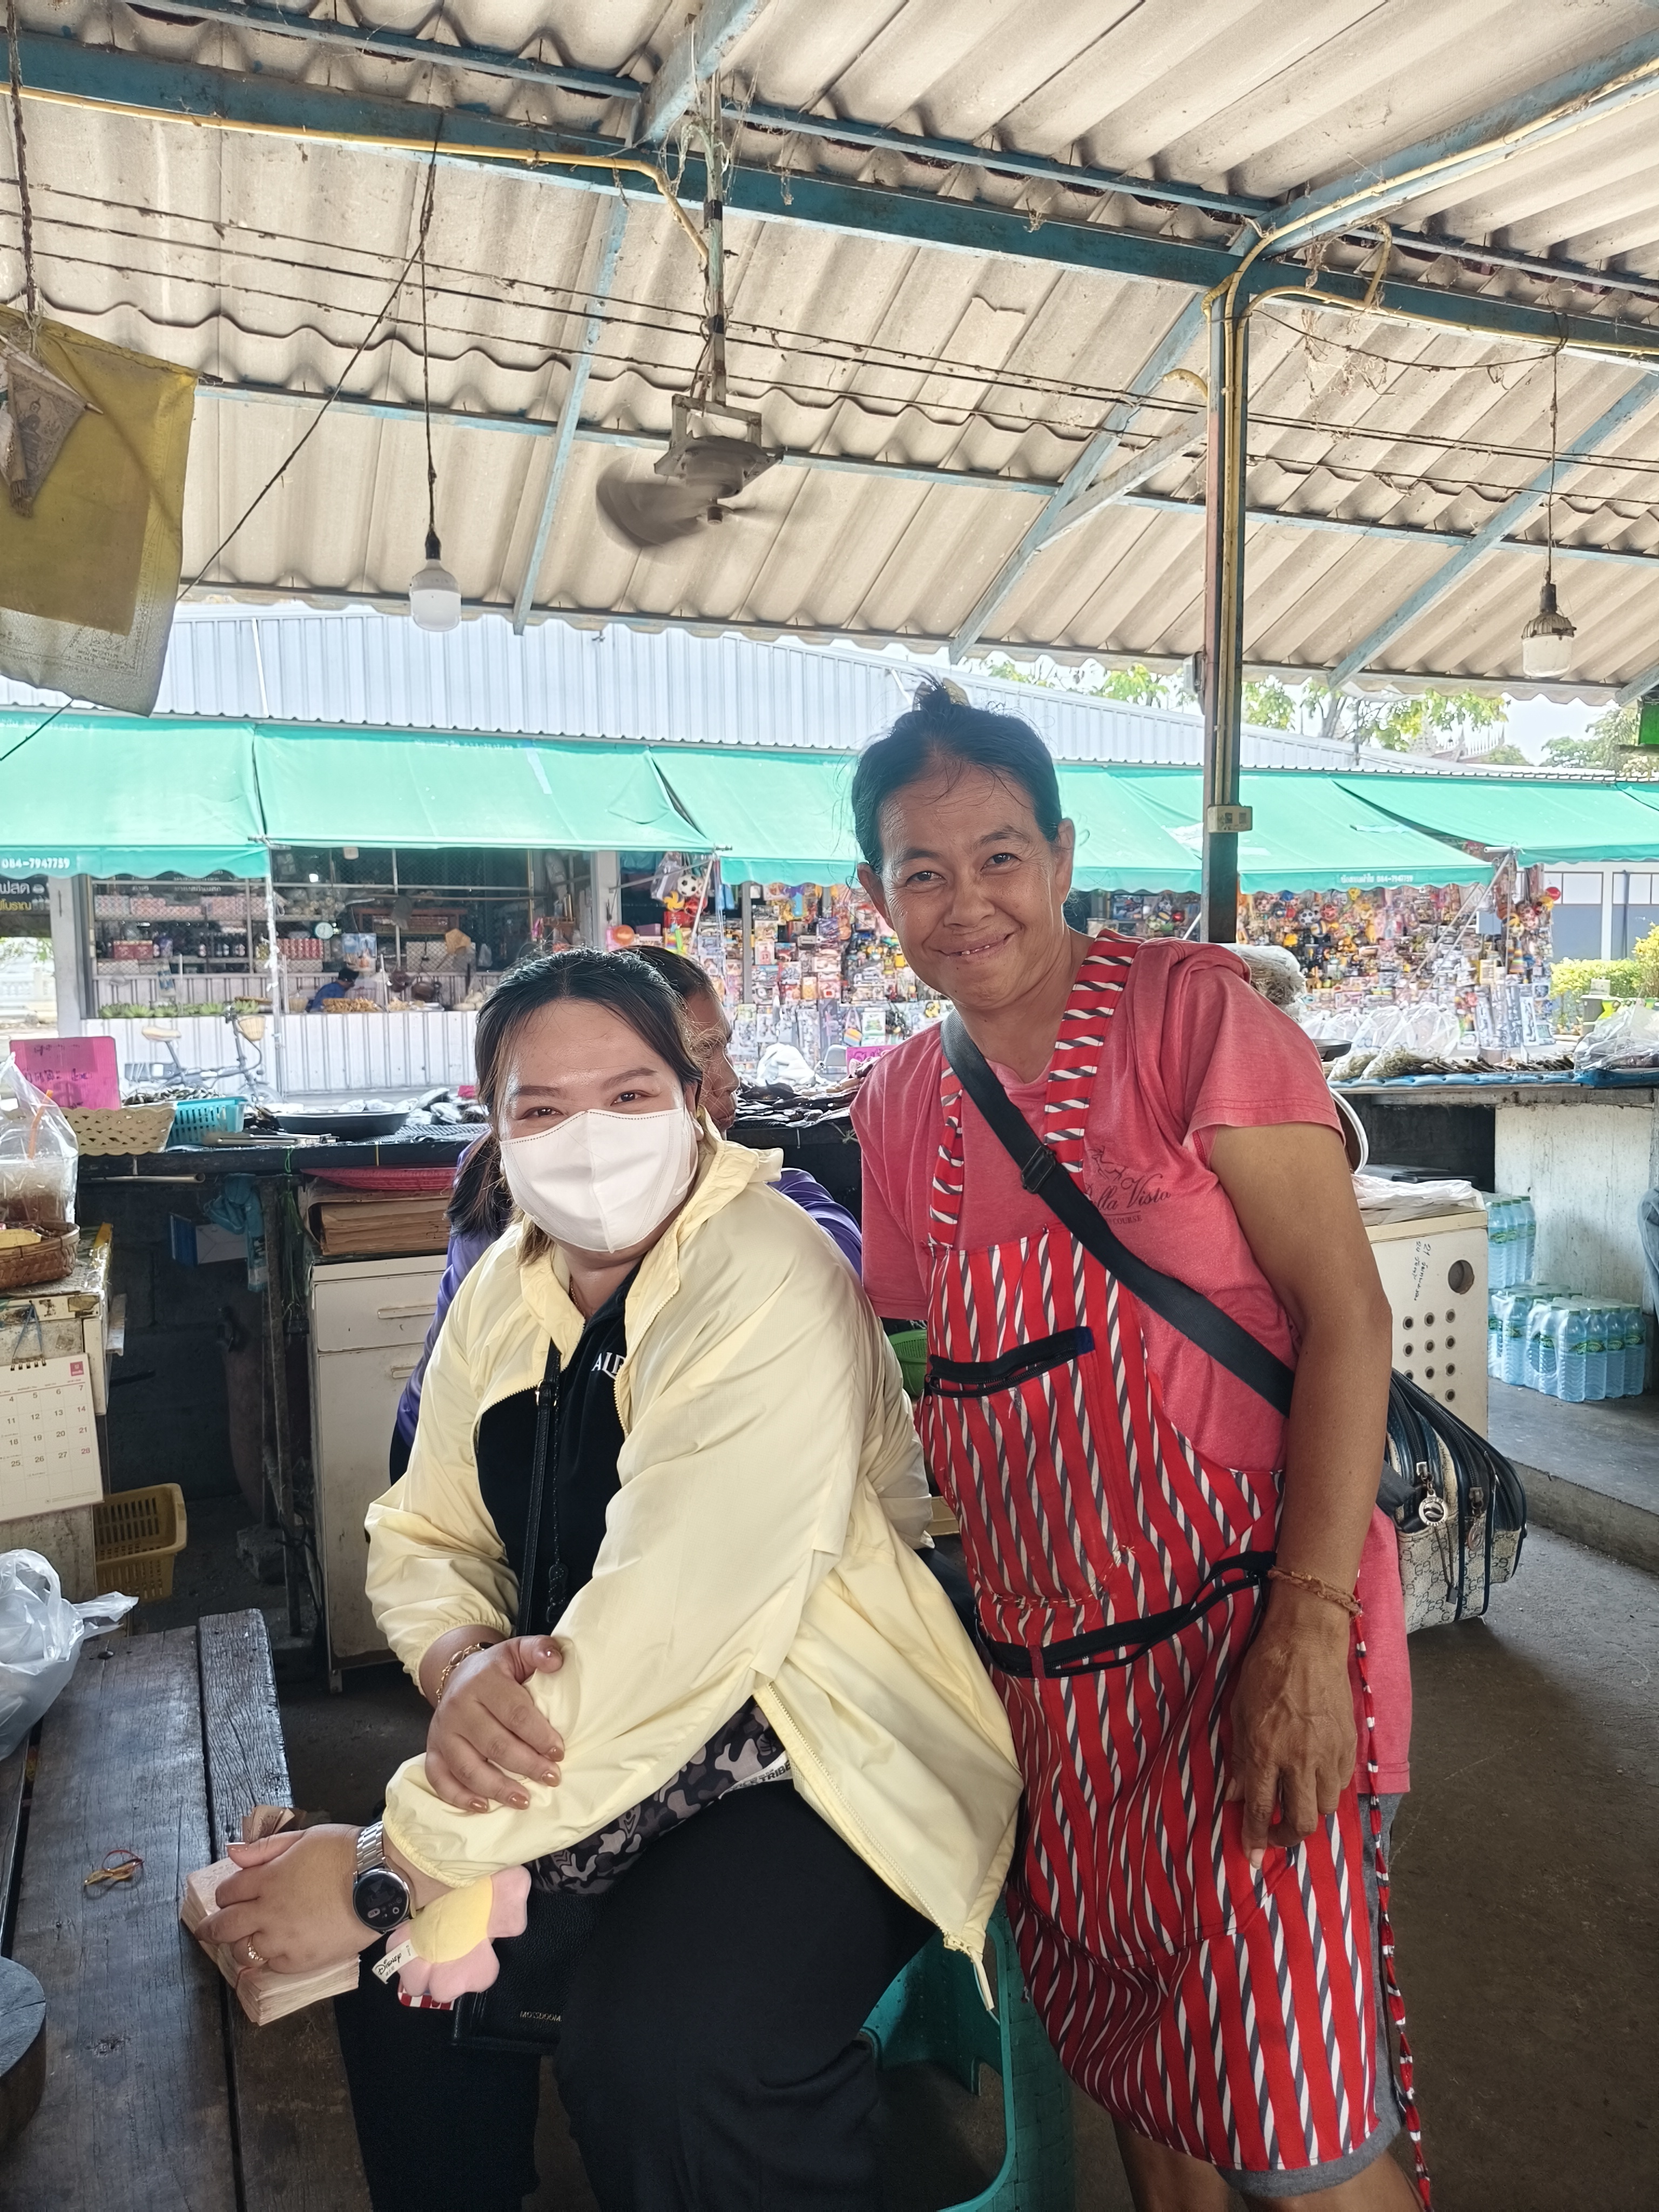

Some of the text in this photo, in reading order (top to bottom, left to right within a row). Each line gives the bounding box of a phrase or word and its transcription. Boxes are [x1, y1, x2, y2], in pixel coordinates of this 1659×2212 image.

[1121, 1173, 1171, 1208] Vista
[1112, 1215, 1143, 1225] COURSE
[759, 1759, 791, 1782] TRIBE
[375, 1953, 402, 1975] Disney
